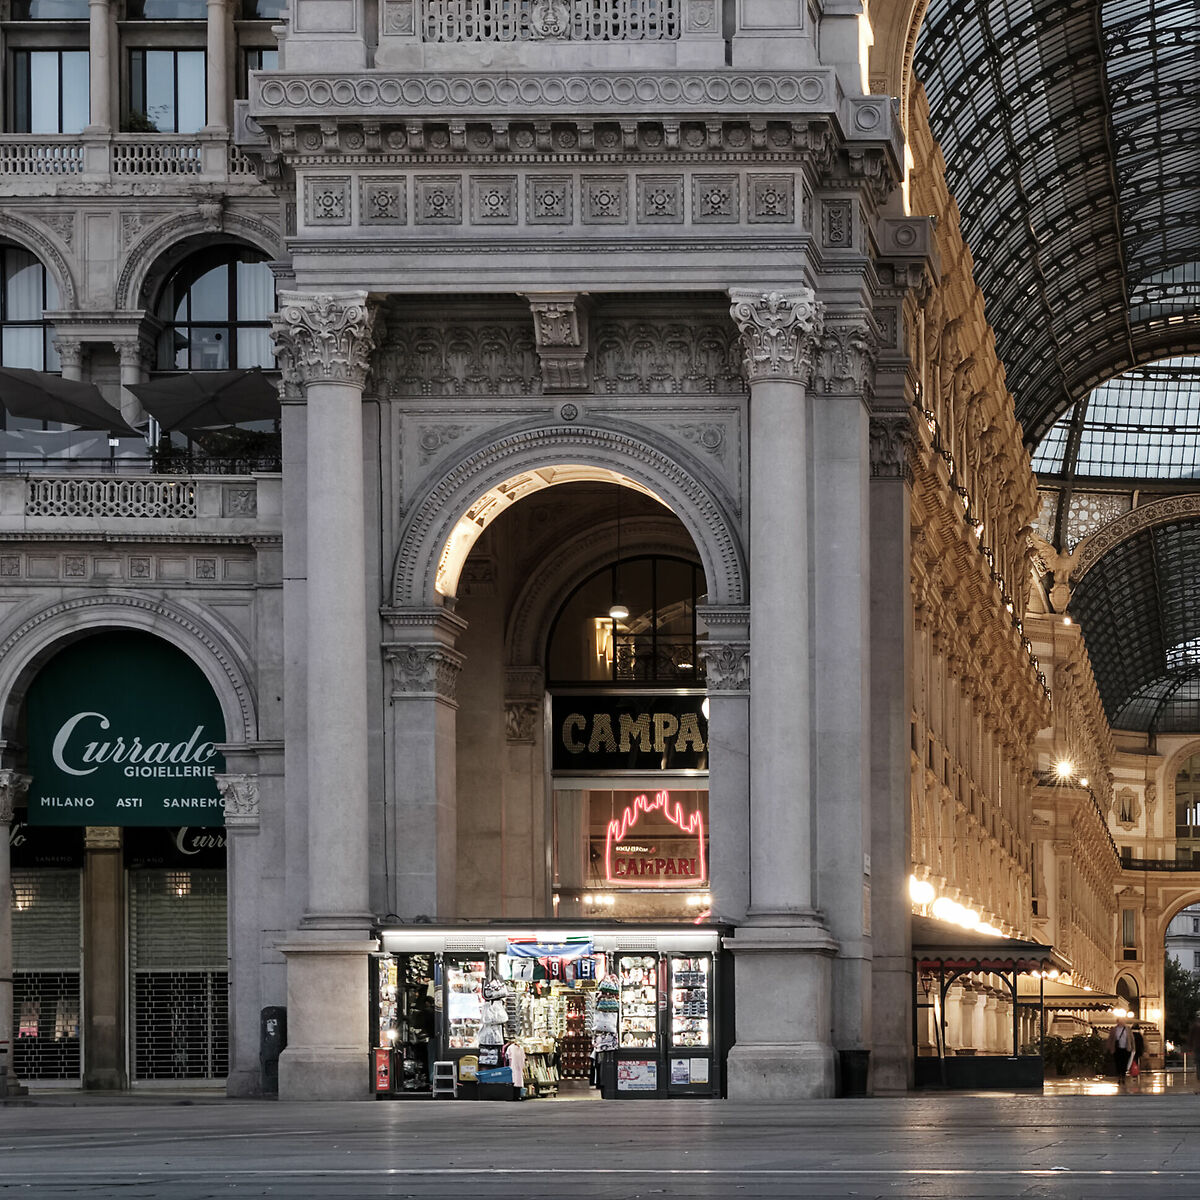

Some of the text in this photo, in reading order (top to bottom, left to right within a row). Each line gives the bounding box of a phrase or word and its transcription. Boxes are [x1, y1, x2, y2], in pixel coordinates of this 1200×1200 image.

[562, 712, 709, 754] CAMPA
[52, 711, 217, 776] Currado
[124, 766, 215, 777] GIOIELLERIE
[40, 798, 95, 807] MILANO
[116, 798, 143, 807] ASTI
[614, 857, 696, 876] CAMPARI
[520, 964, 527, 977] 7
[551, 962, 559, 976] 9
